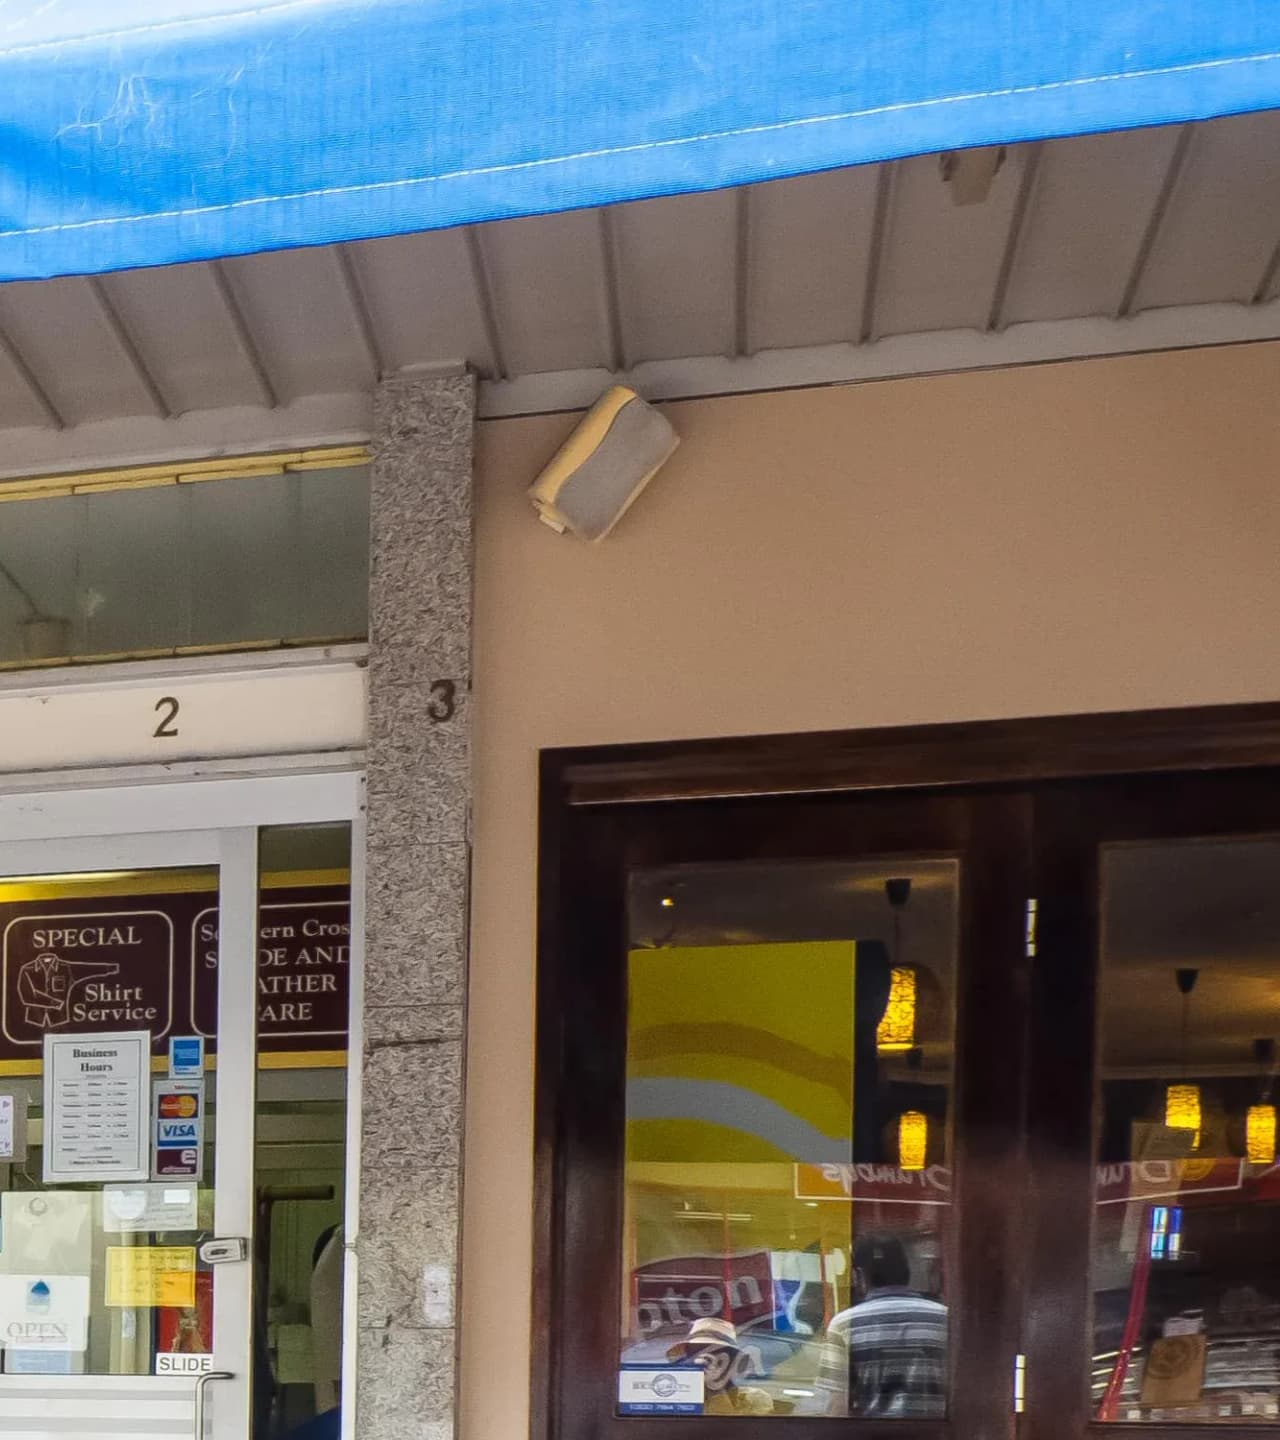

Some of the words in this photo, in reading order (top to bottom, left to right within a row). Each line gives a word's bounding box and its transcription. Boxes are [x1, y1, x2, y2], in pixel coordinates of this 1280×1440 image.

[428, 679, 456, 722] 3
[153, 697, 179, 738] 2
[32, 926, 142, 948] SPECIAL
[85, 984, 143, 1002] Shirt
[73, 1003, 157, 1022] Service
[73, 1048, 118, 1059] Business
[80, 1062, 113, 1072] Hours
[163, 1125, 196, 1137] VISA
[6, 1320, 68, 1338] OPEN
[159, 1357, 211, 1371] SLIDE
